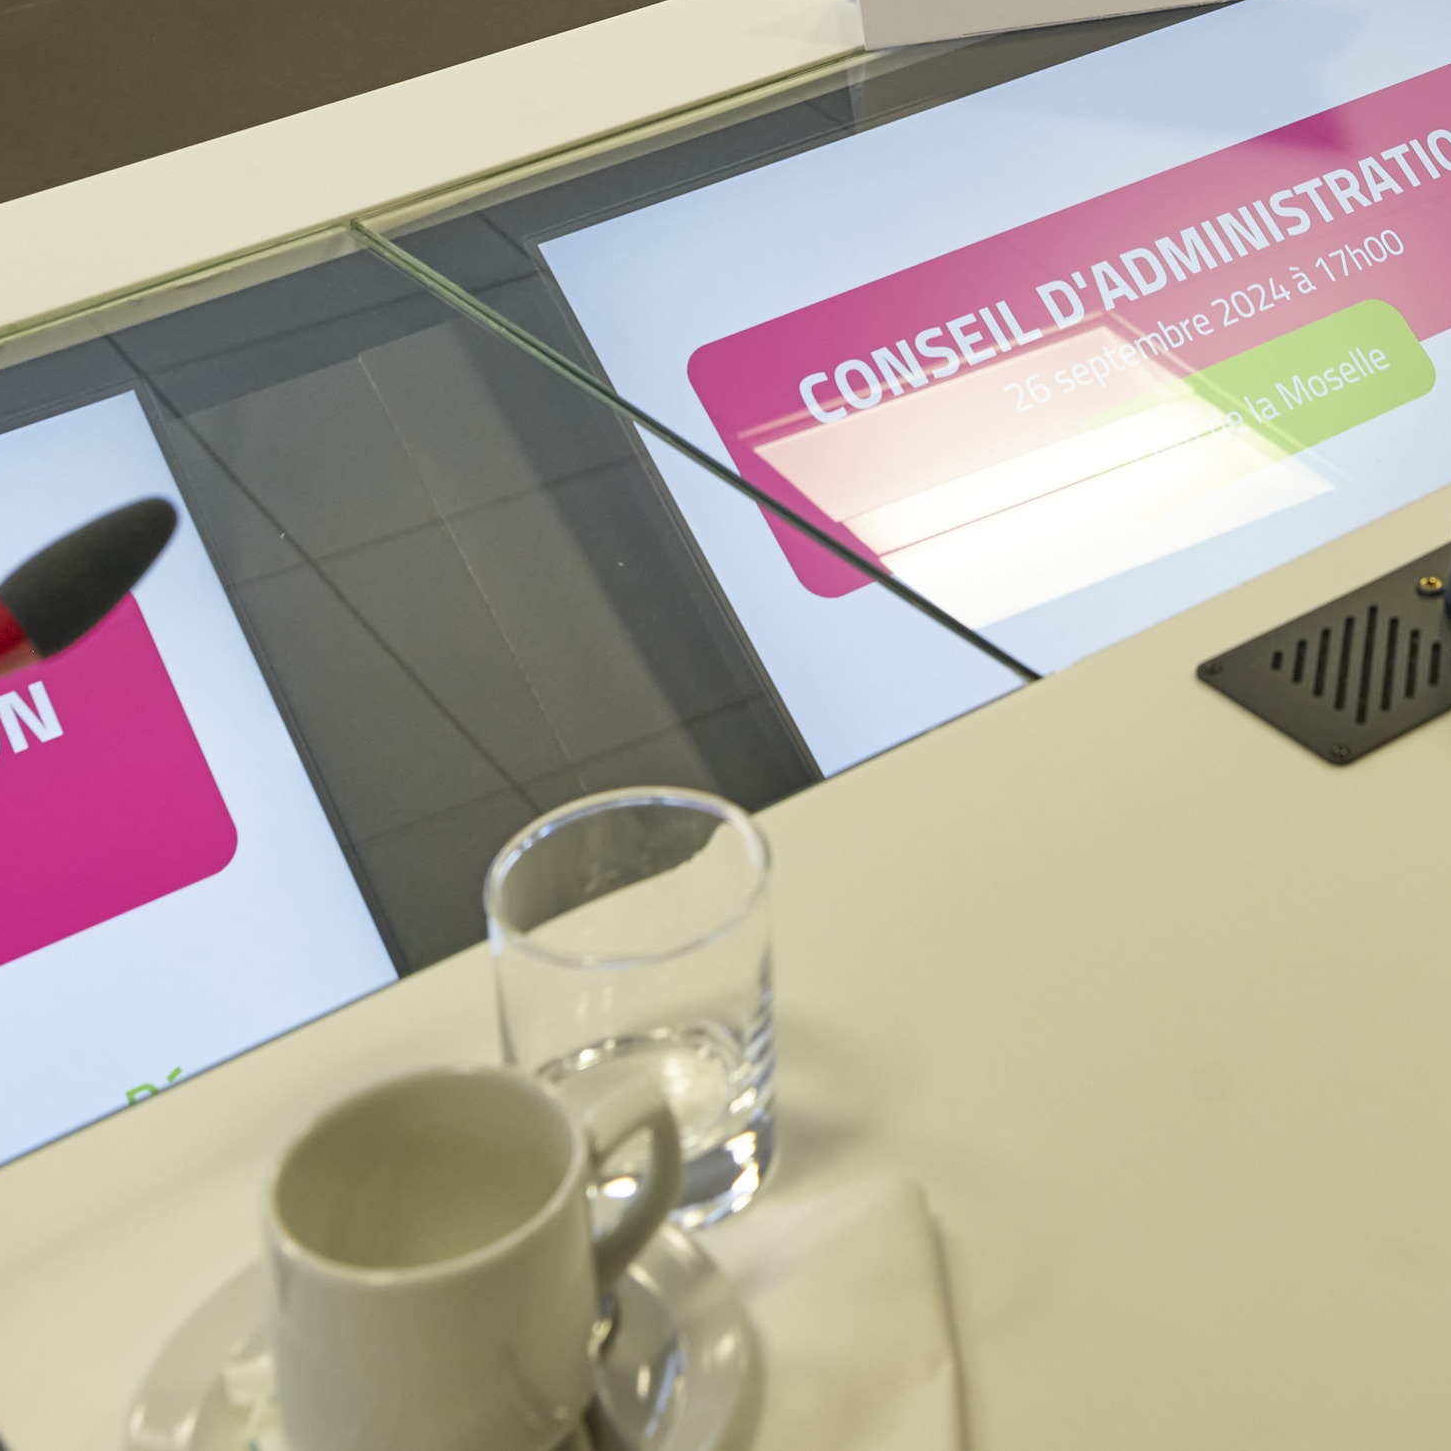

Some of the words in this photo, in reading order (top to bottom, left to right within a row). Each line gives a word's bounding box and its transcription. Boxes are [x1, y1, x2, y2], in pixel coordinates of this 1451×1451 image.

[799, 300, 1043, 425] CONSEIL
[1004, 373, 1052, 414] 26
[1054, 311, 1214, 394] septembre
[1211, 277, 1291, 327] 2024
[1289, 266, 1316, 294] à
[1315, 229, 1406, 282] 17h00
[1243, 396, 1280, 425] la
[1275, 348, 1392, 411] Moselle
